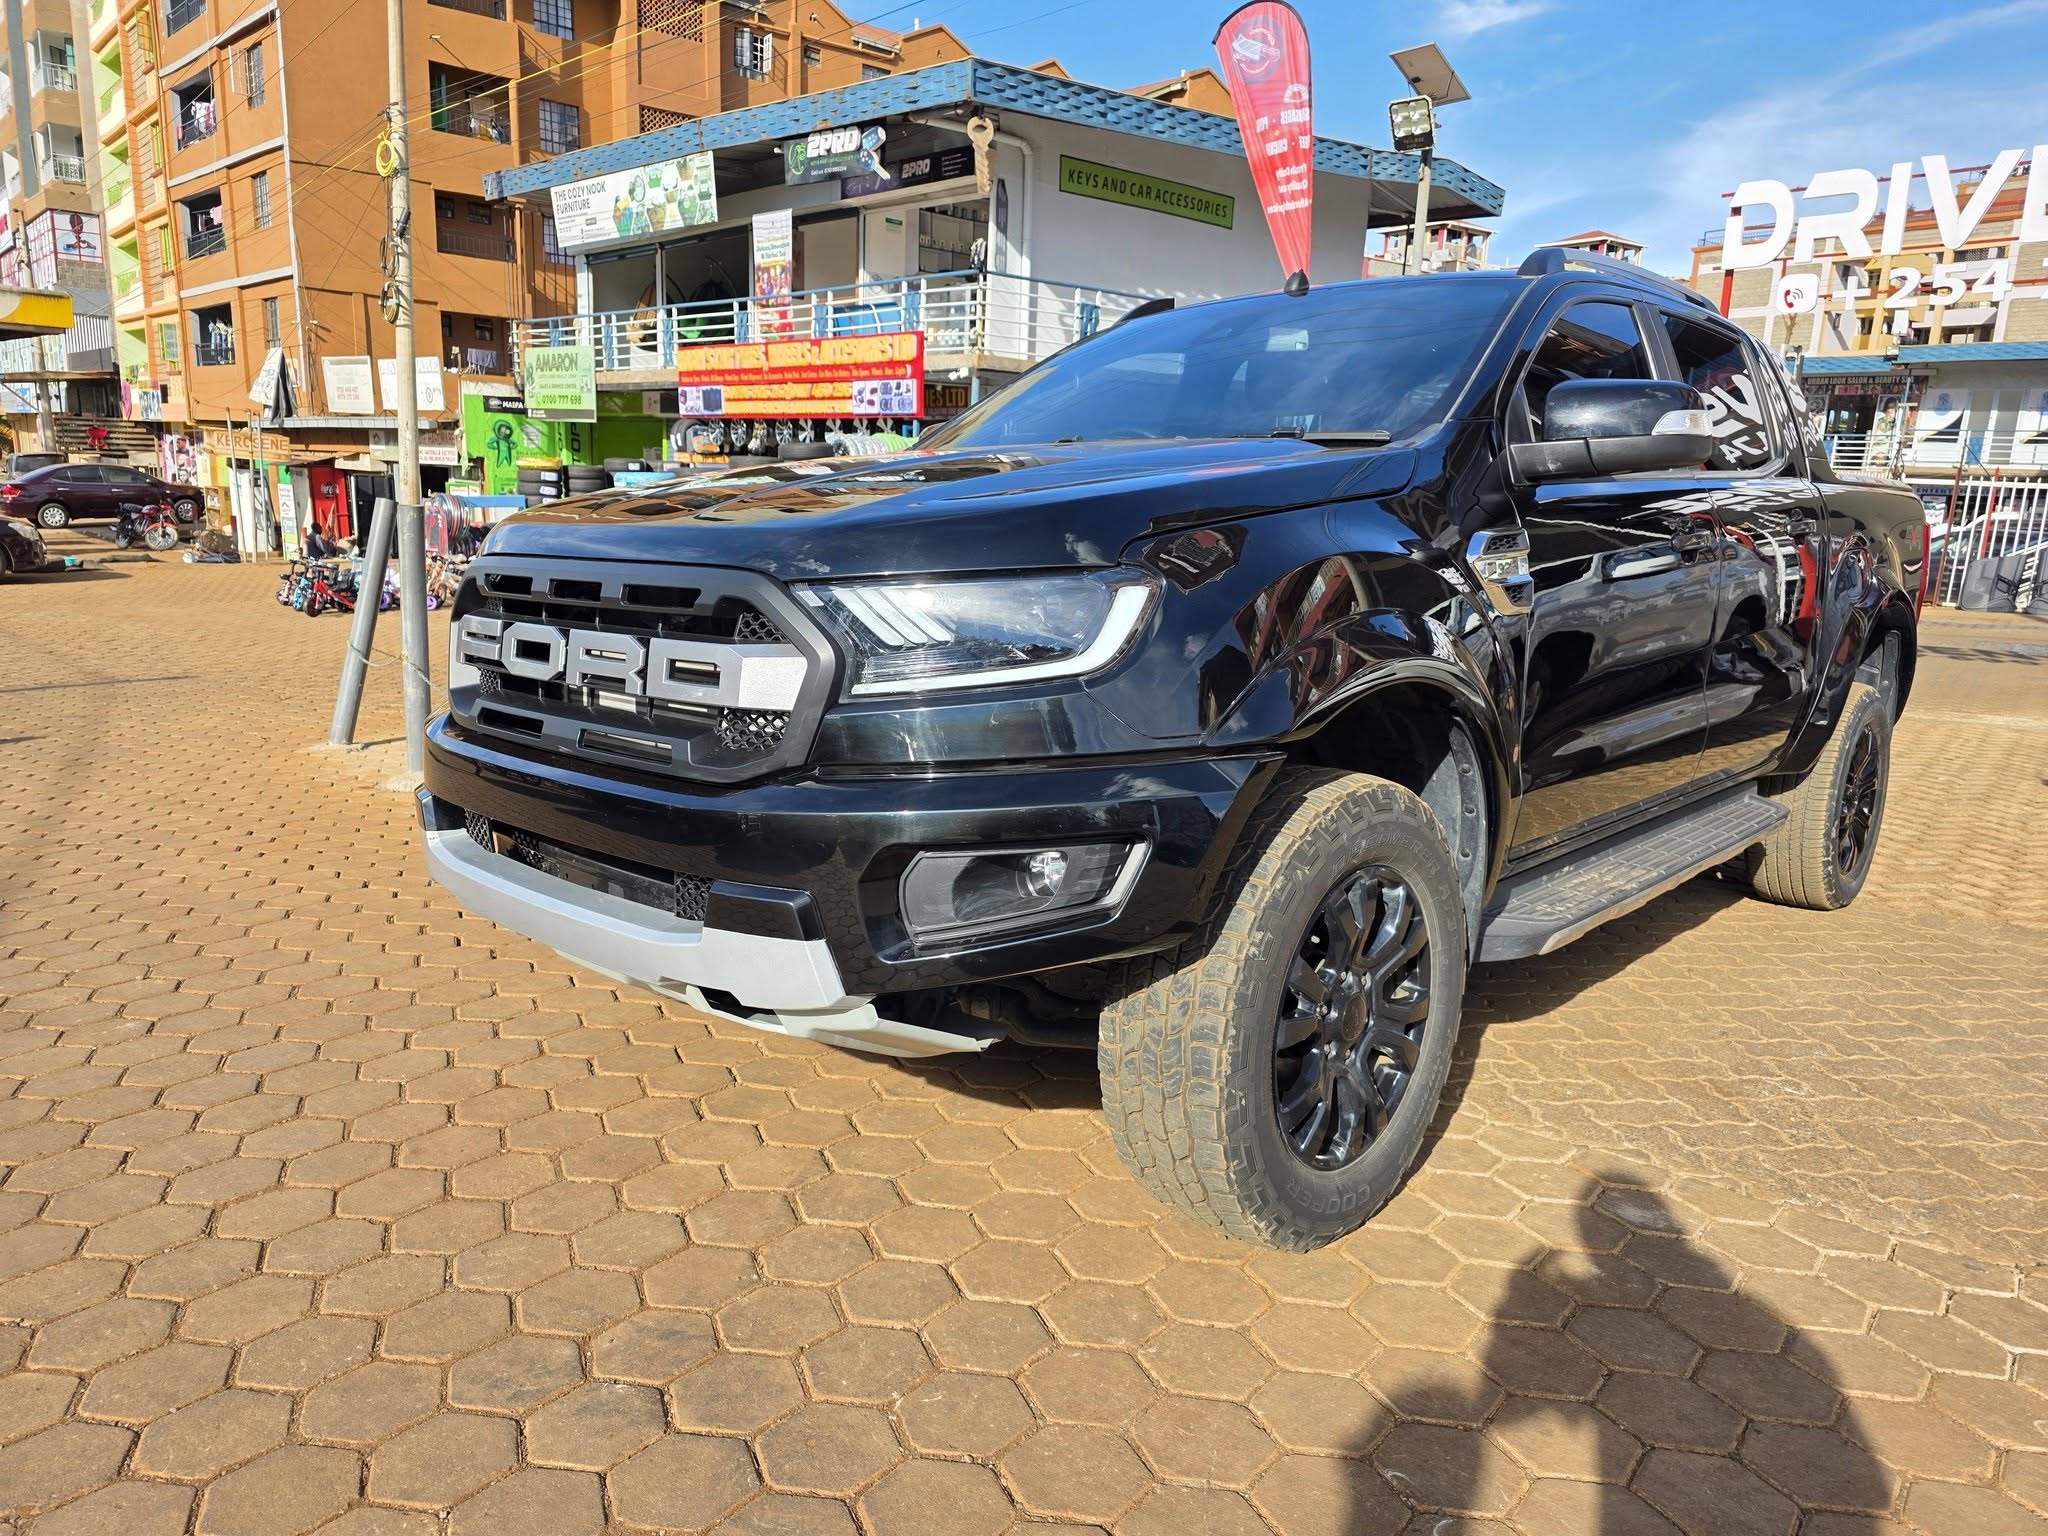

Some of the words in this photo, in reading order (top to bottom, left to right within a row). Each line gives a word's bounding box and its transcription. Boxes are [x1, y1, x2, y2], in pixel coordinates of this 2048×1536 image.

[806, 126, 862, 158] 2PRO
[902, 158, 931, 180] 2PRO
[554, 190, 567, 202] THE
[568, 185, 585, 199] COZY
[586, 181, 606, 194] NOOK
[1068, 169, 1098, 188] KEYS
[1102, 177, 1127, 194] AND
[1130, 182, 1152, 200] CAR
[1154, 189, 1227, 218] ACCESSORIES
[556, 198, 590, 215] FURNITURE
[535, 353, 578, 372] AMARON
[1807, 377, 1829, 385] URBAN
[1874, 376, 1900, 384] BEAUTY
[542, 395, 557, 404] 0700
[558, 395, 569, 404] 777
[945, 388, 965, 407] LTD
[216, 434, 289, 450] KEROSENE
[449, 613, 742, 709] FORD
[1330, 830, 1440, 880] DISCOVERER
